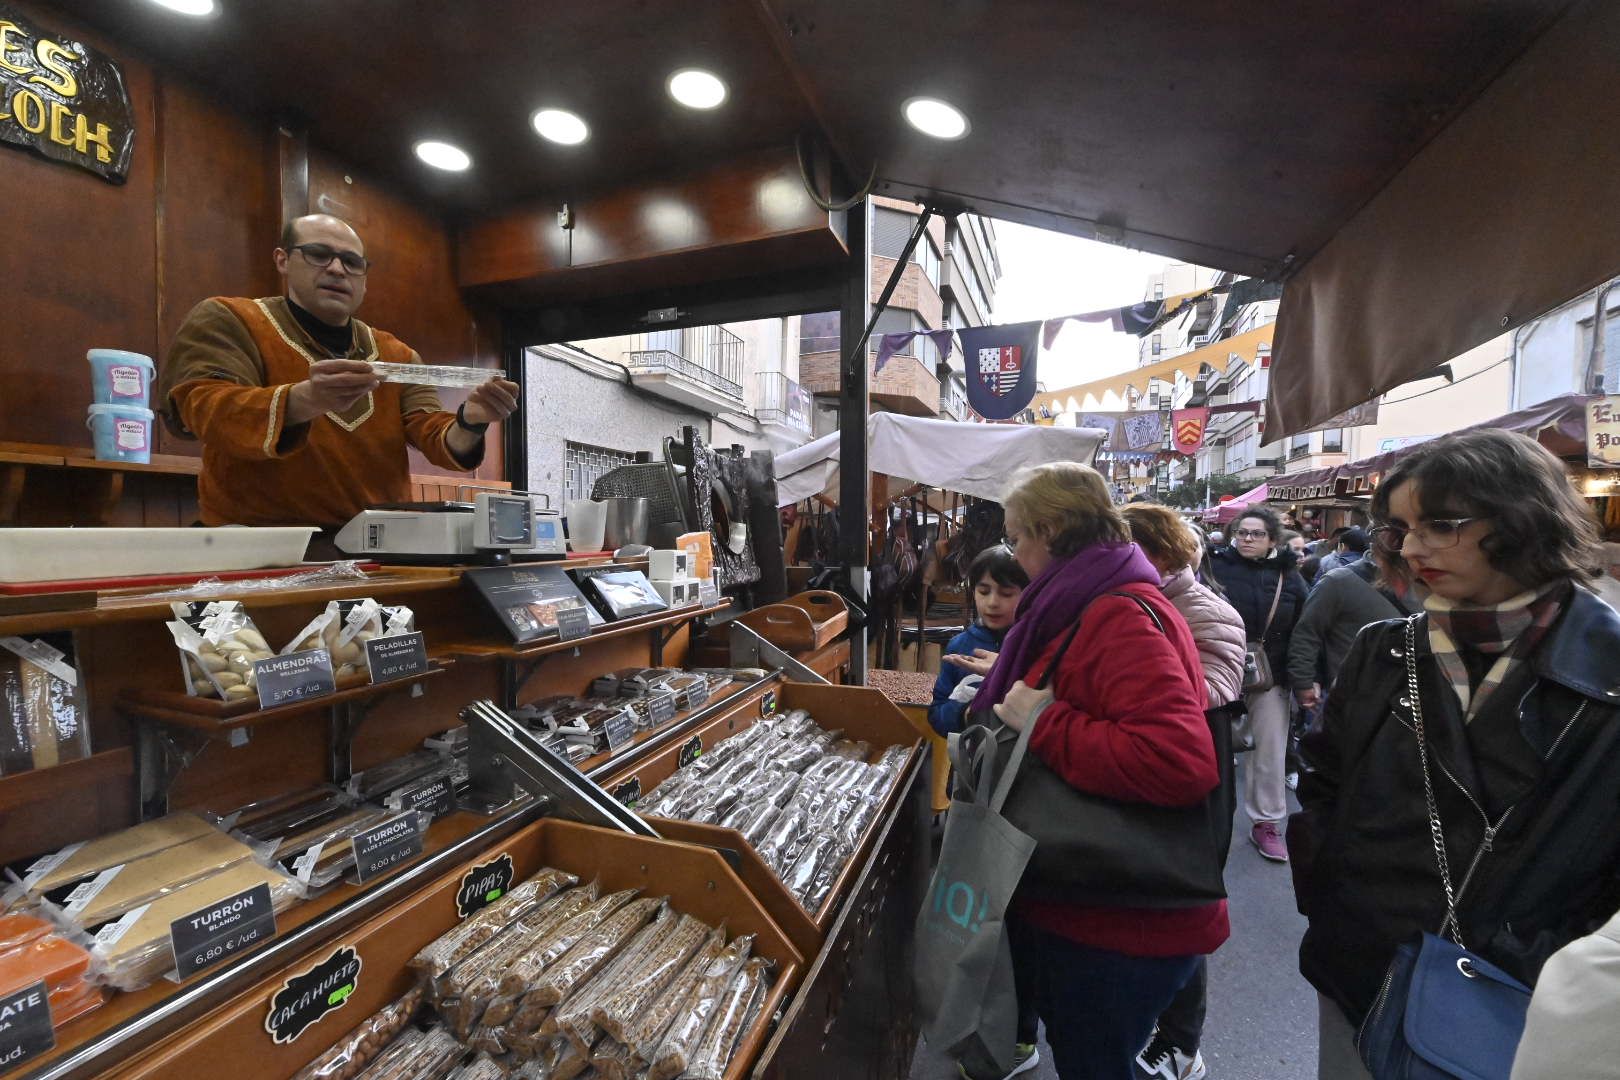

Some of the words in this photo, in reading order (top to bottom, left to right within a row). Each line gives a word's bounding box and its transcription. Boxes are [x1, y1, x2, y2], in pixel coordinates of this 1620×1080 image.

[374, 638, 417, 651] PELADILLAS
[257, 654, 327, 674] ALMENDRAS
[411, 782, 444, 802] TURRÓN
[366, 820, 408, 845] TURRÓN
[367, 844, 378, 852] LOS
[382, 827, 414, 846] CHOCOLATES
[370, 857, 389, 872] 8,00
[390, 853, 396, 861] €
[464, 870, 504, 904] PIPAS
[190, 895, 254, 930] TURRÓN
[208, 913, 241, 932] BLANDO
[195, 946, 223, 965] 6,80
[226, 940, 235, 950] €
[237, 929, 260, 947] /ud.
[271, 960, 356, 1030] CACAHUETE
